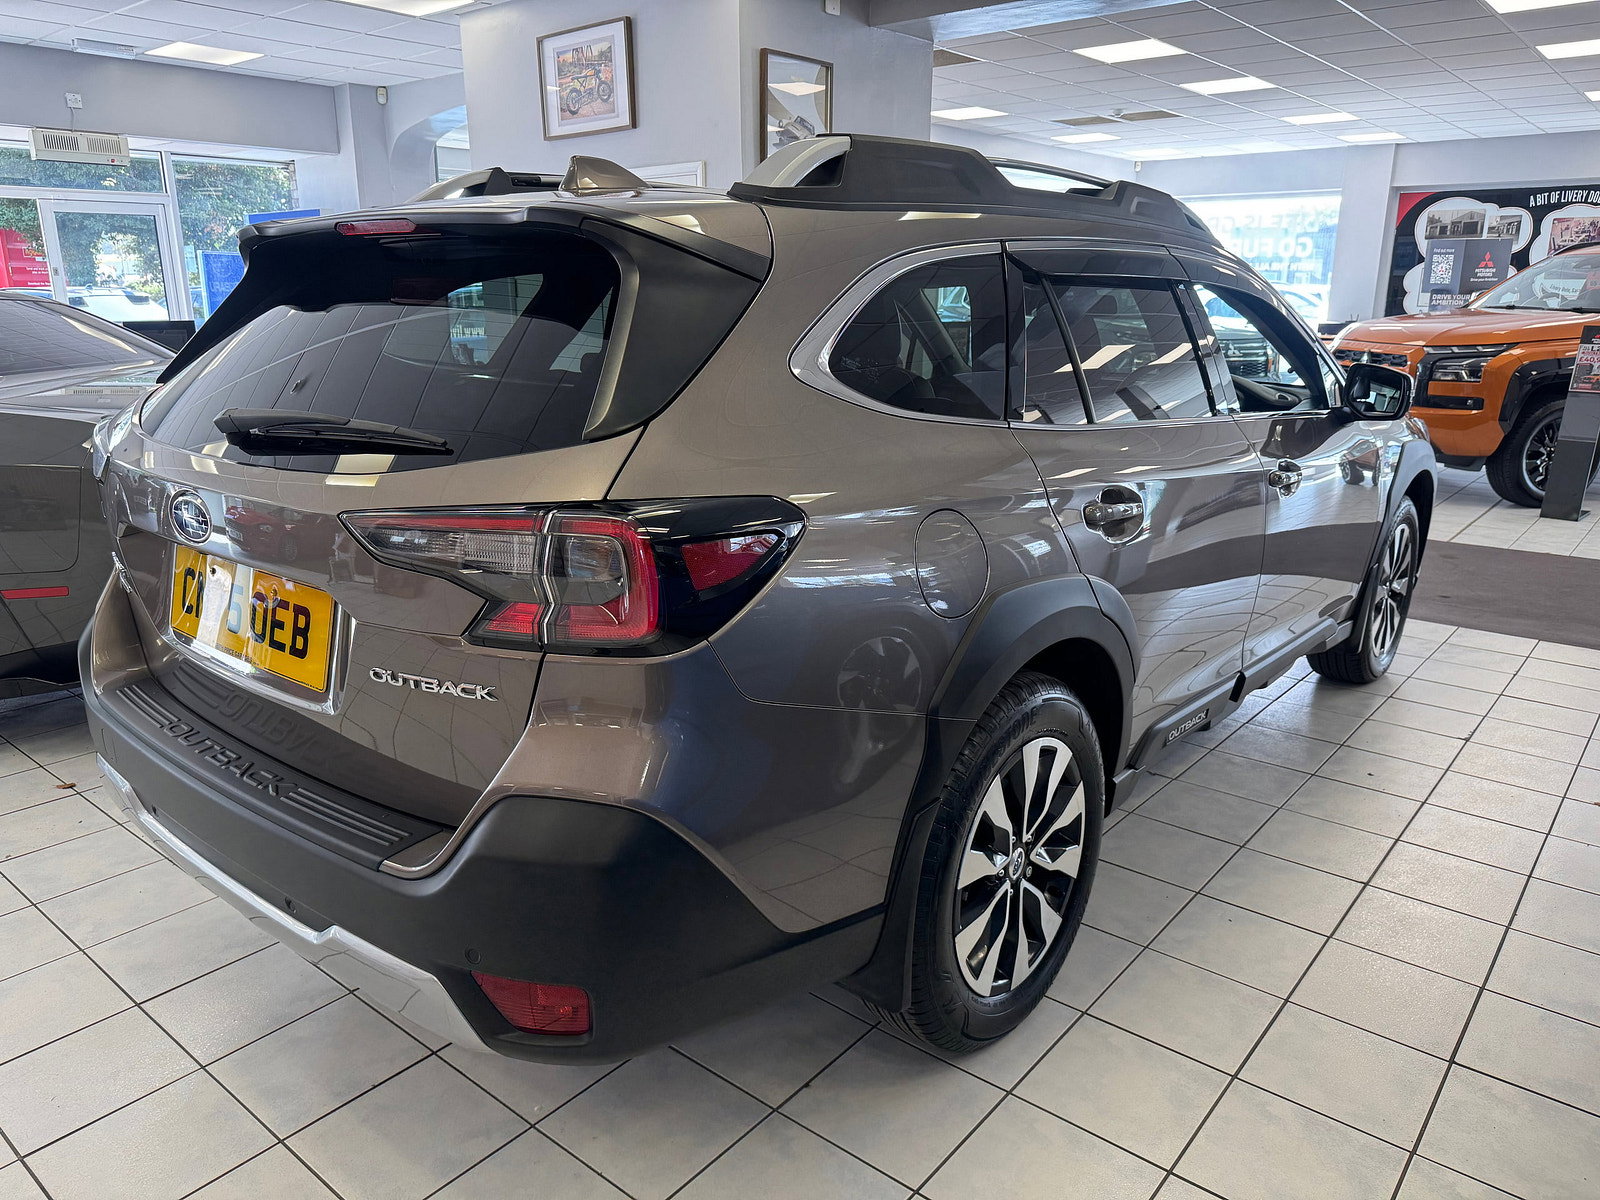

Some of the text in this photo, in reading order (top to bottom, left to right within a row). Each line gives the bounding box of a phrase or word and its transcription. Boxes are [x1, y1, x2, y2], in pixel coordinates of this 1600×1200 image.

[1529, 196, 1536, 207] A
[1536, 192, 1549, 206] BIT
[1550, 190, 1561, 204] OF
[1561, 189, 1588, 203] LIVERY
[250, 591, 311, 660] OEB
[369, 666, 498, 702] OUTBACK
[1168, 709, 1207, 741] OUTBACK
[163, 719, 298, 797] OUTBACK
